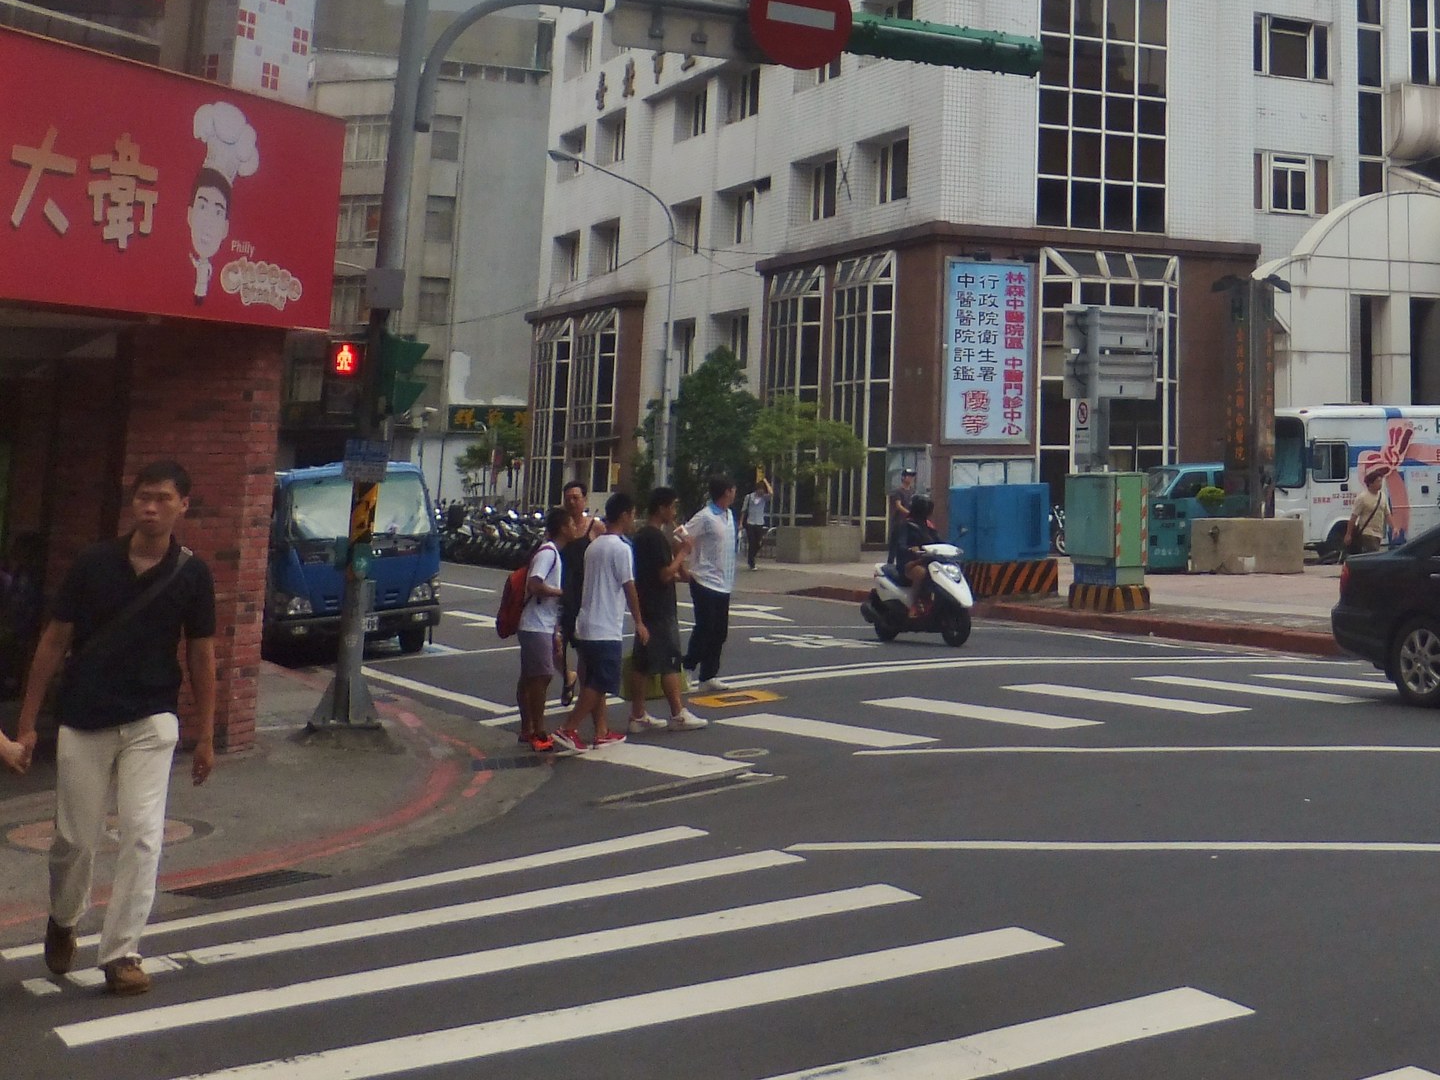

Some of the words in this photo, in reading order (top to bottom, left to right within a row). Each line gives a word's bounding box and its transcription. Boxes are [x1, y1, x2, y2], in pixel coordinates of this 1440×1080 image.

[11, 125, 158, 250] 大衛
[231, 240, 255, 258] Philly
[953, 273, 976, 382] 中醫醫院評鑑
[977, 273, 999, 382] 行政院衛生署
[961, 390, 990, 436] 優等
